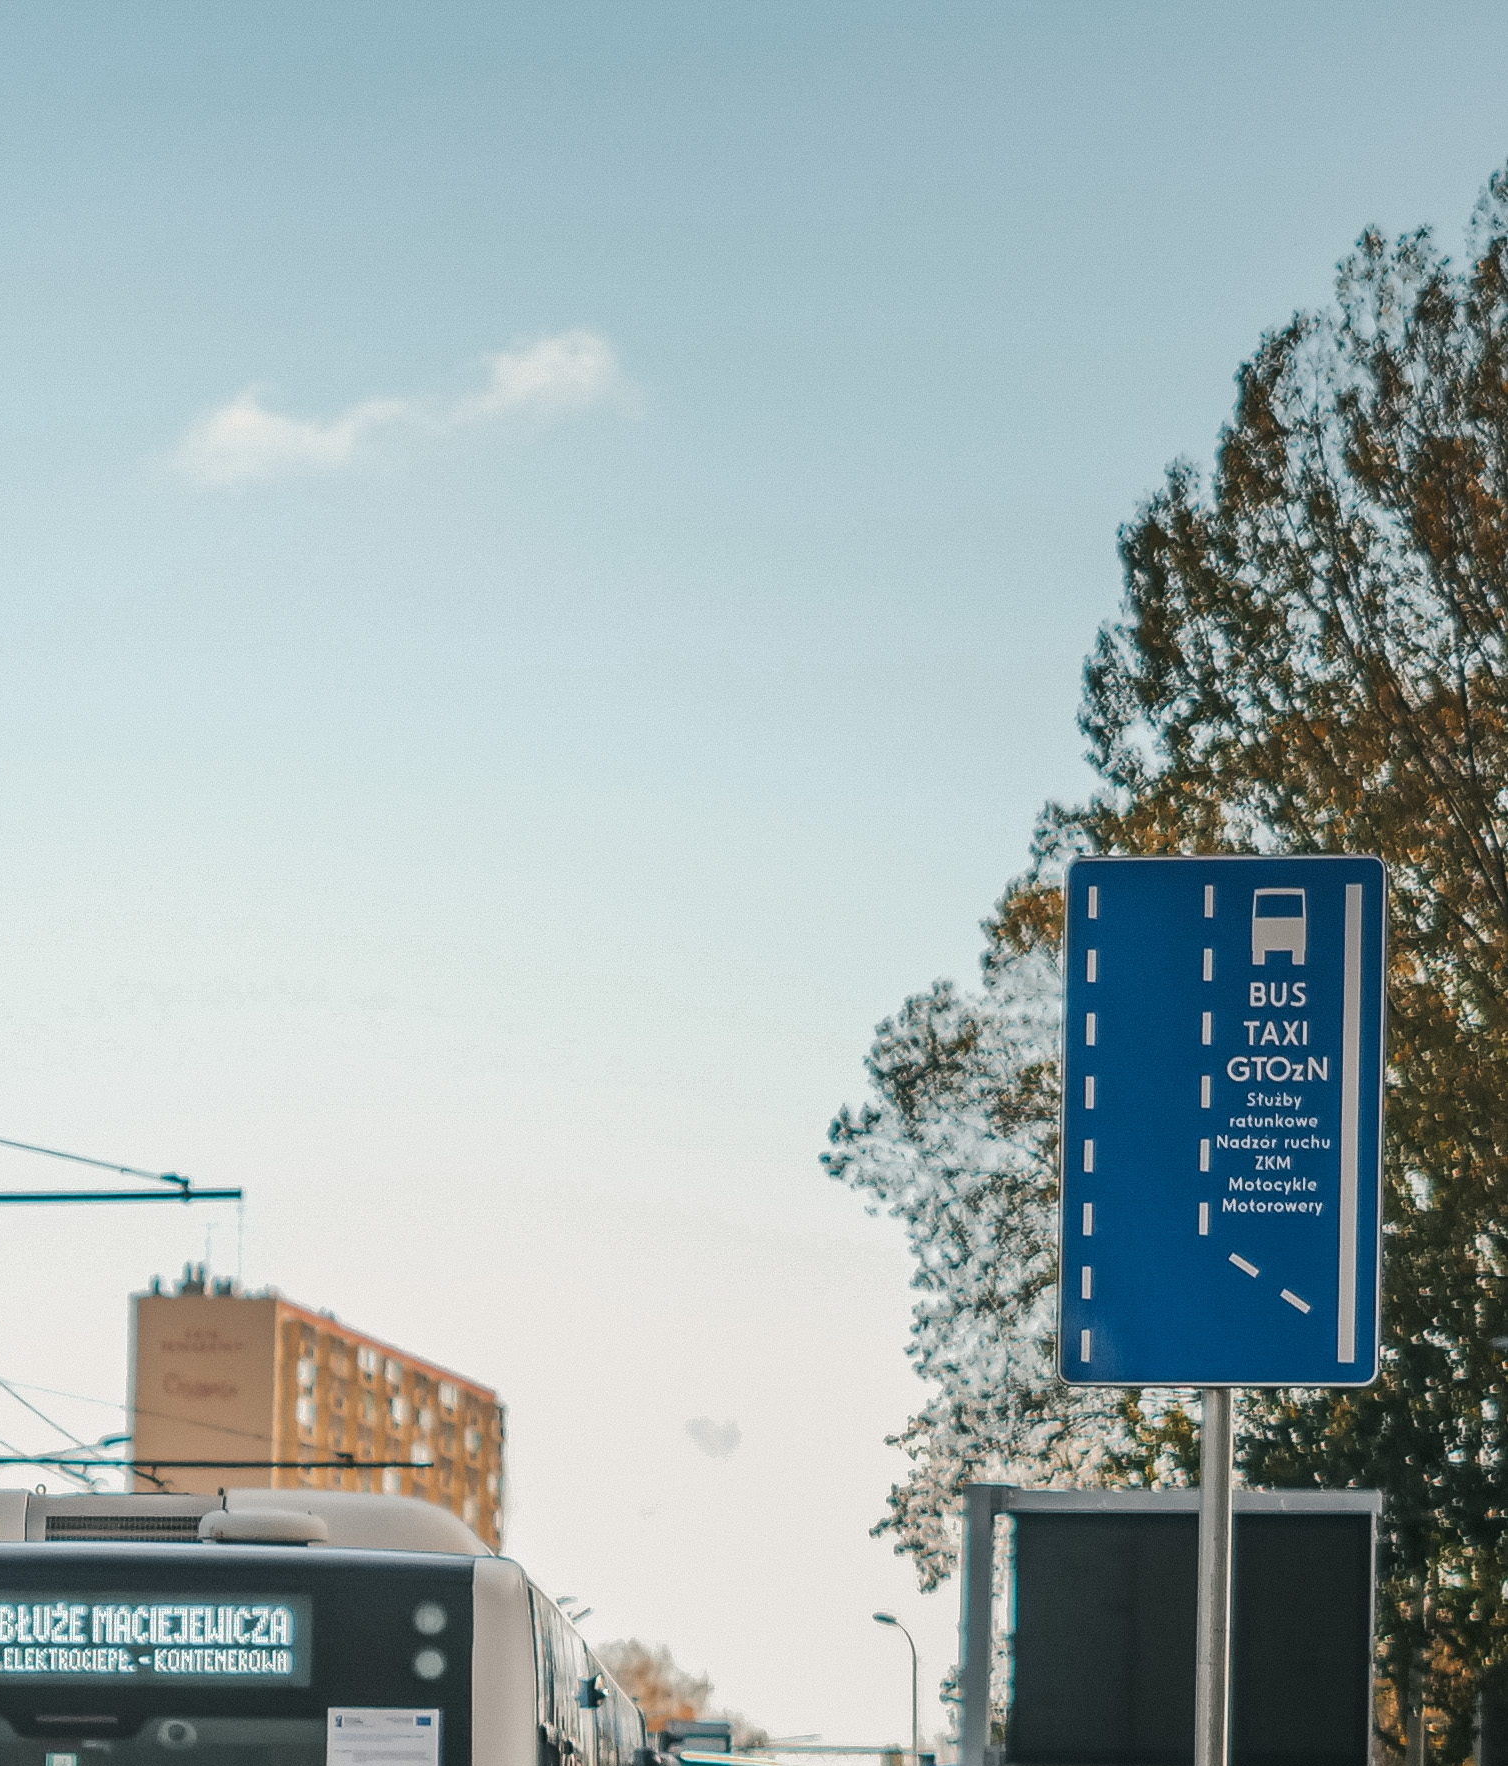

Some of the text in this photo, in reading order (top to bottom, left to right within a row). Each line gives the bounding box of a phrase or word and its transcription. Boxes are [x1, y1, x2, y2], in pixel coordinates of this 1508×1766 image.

[1249, 981, 1307, 1008] BUS
[1243, 1020, 1308, 1047] TAXI
[1226, 1056, 1328, 1082] GTOzN
[1246, 1091, 1302, 1111] Służby
[1228, 1112, 1319, 1129] ratunkowe
[1216, 1133, 1331, 1150] Nadzór ruchu
[1254, 1155, 1293, 1171] ZKM
[1228, 1176, 1318, 1196] Motocykle
[1222, 1198, 1323, 1217] Motorowery
[91, 1605, 293, 1645] MACIEJEWICZA
[153, 1648, 294, 1673] KONTENEROWA
